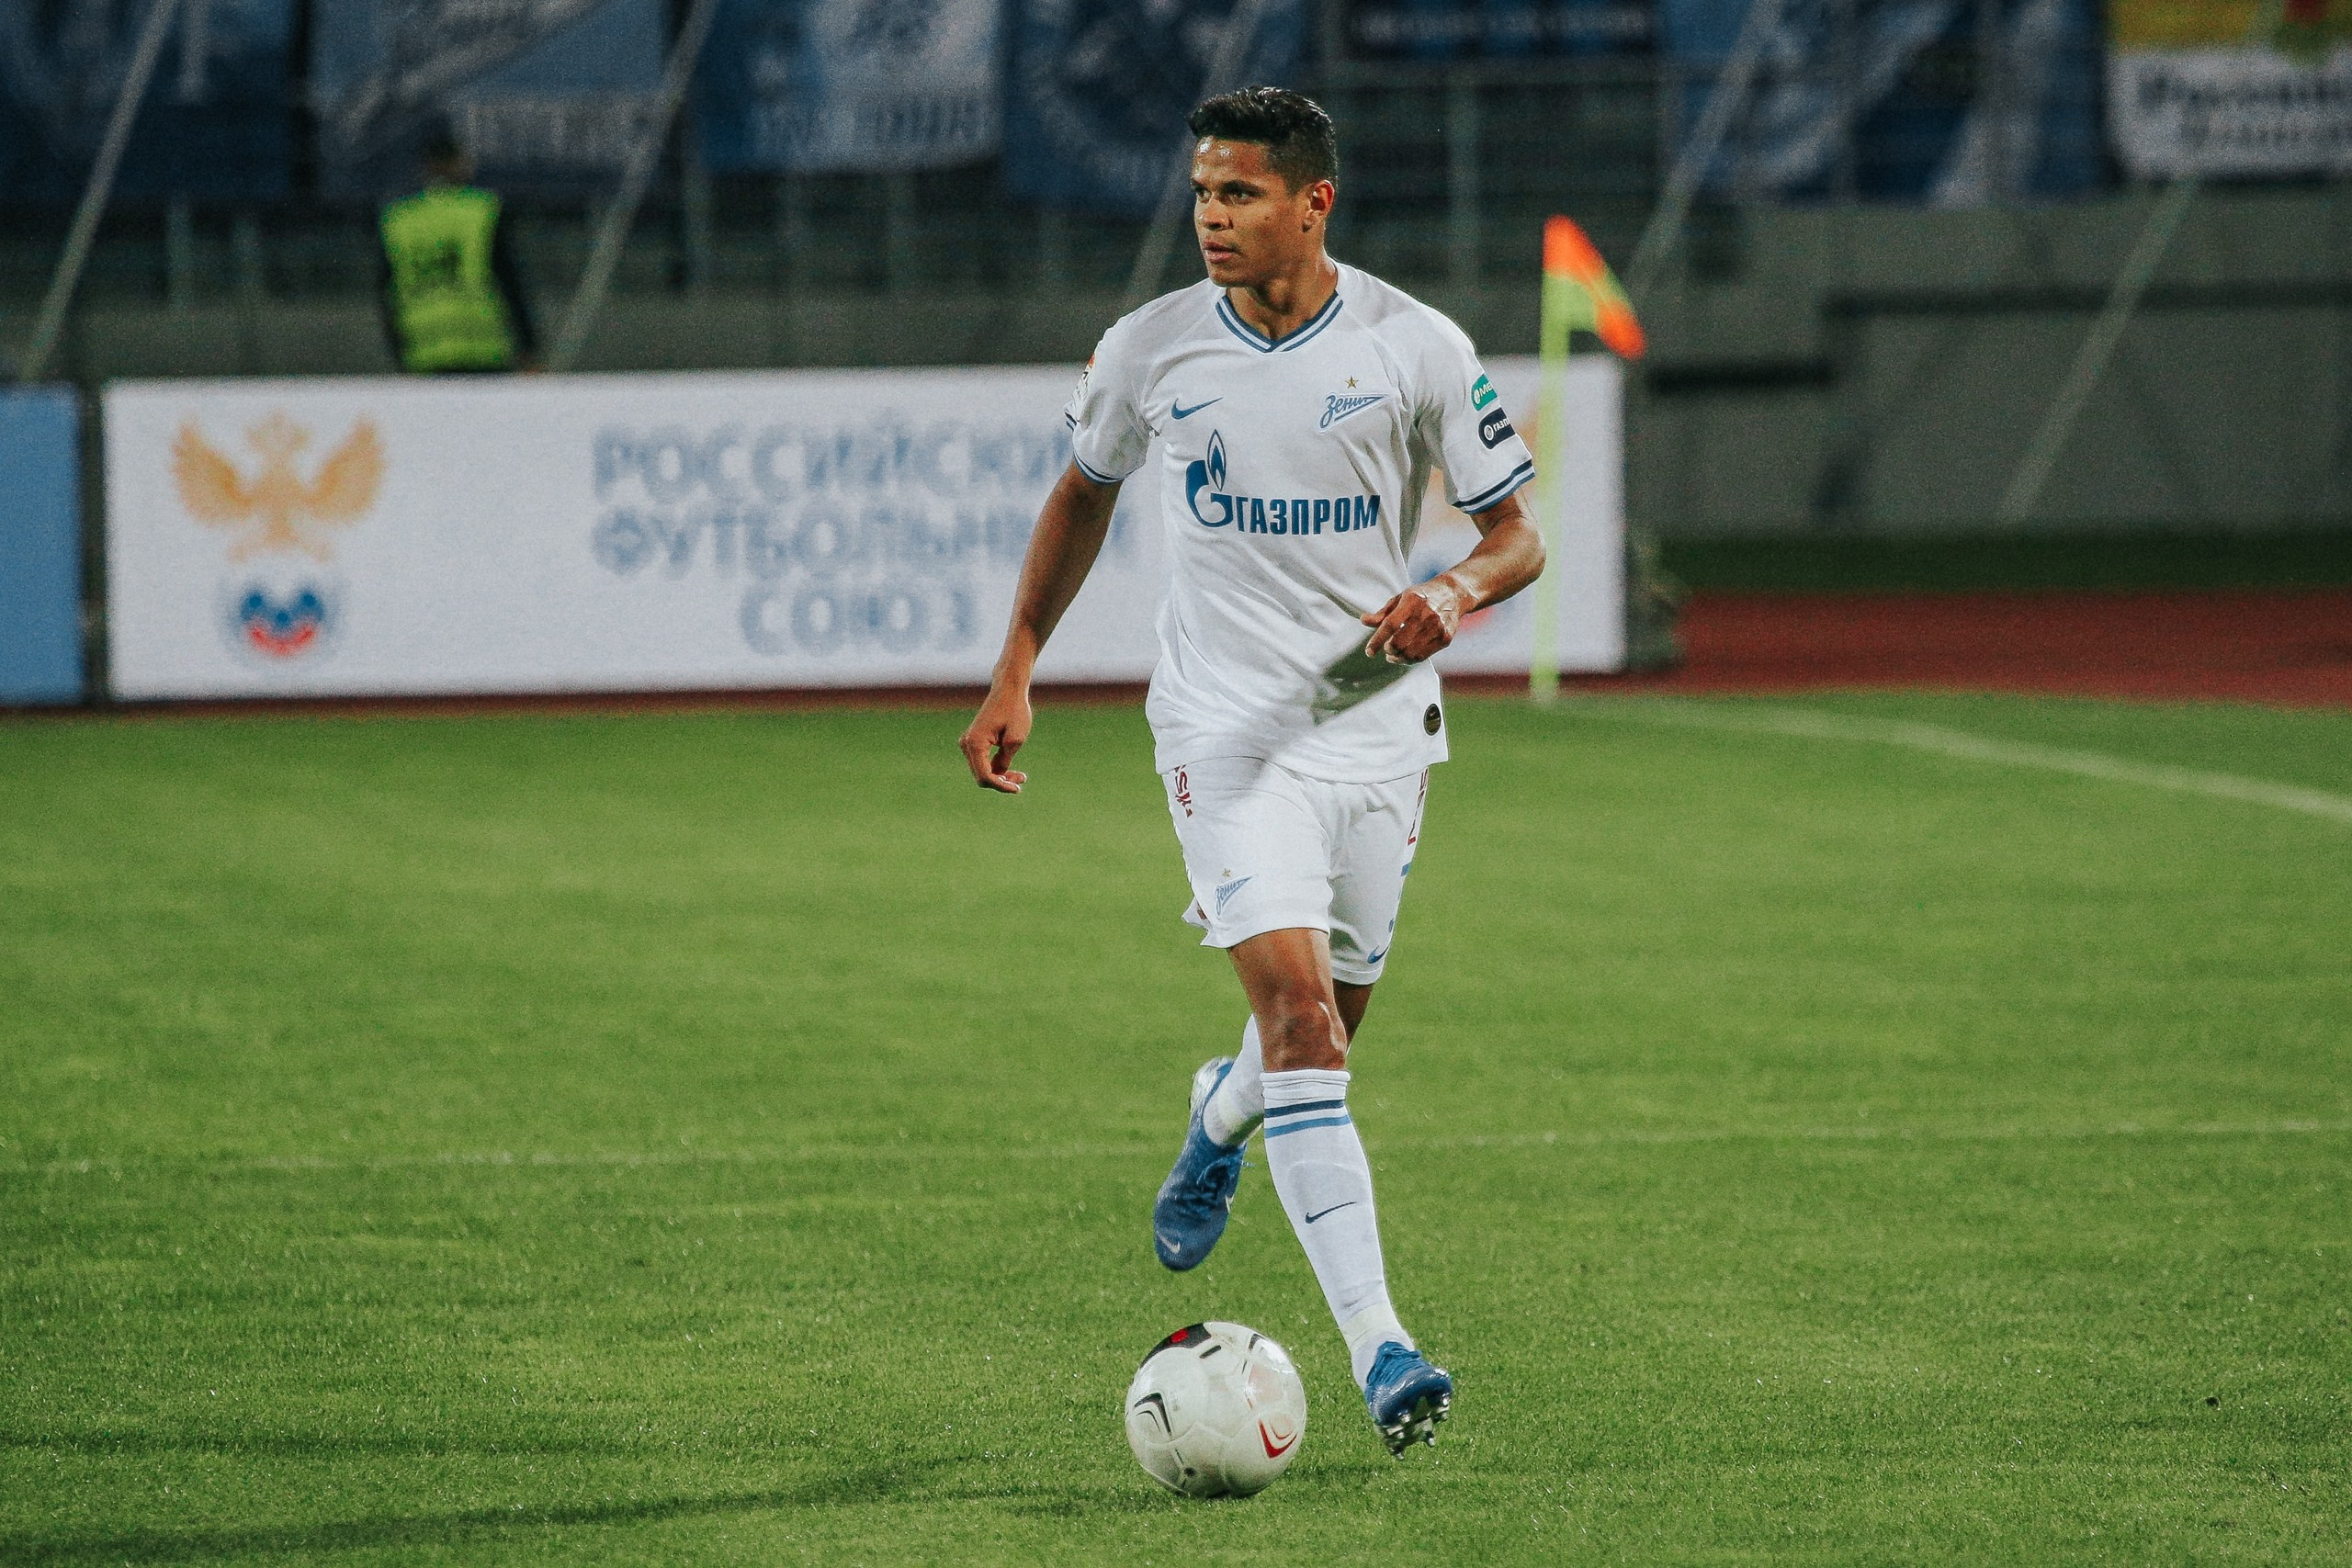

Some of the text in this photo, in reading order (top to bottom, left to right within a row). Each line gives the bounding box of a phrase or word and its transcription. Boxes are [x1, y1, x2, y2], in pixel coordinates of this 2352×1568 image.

[593, 410, 1075, 501] РОССИЙСКИ
[592, 505, 1134, 575] ФУТБОЛЬН
[1235, 494, 1381, 536] ГАЗПРОМ
[739, 579, 979, 656] СОЮЗ
